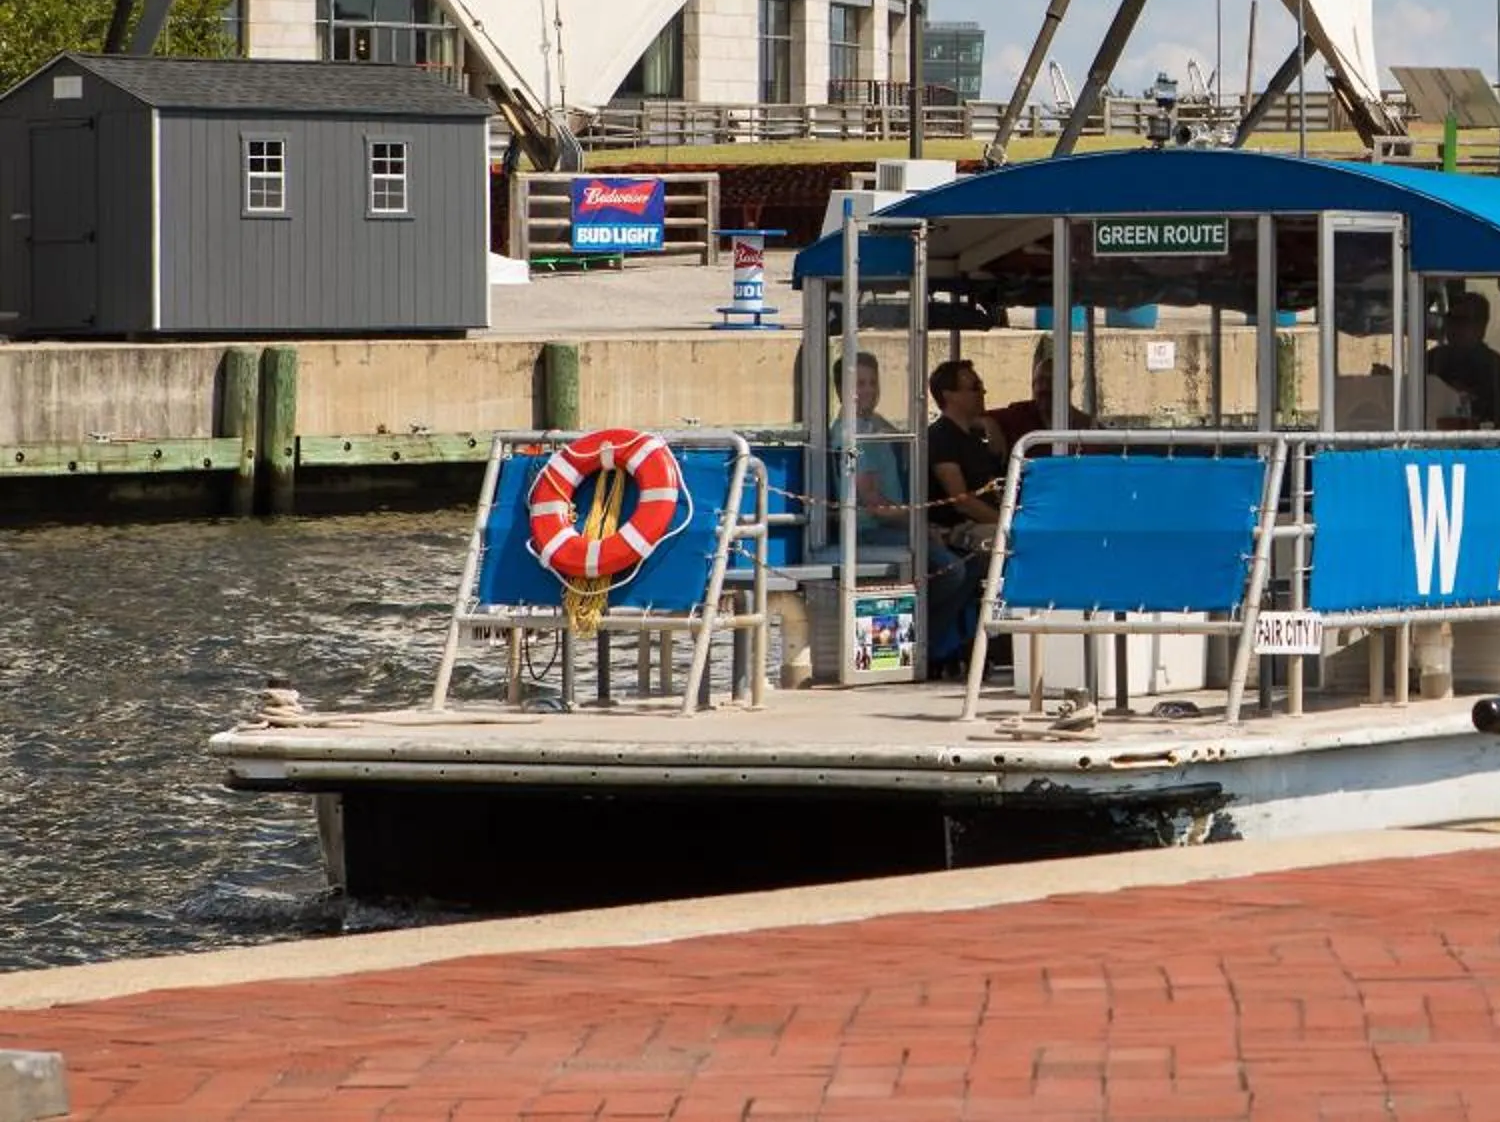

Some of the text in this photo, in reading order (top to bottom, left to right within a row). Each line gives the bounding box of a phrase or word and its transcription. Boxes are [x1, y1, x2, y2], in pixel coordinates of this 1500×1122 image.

[576, 227, 659, 244] BUD LIGHT
[1098, 225, 1225, 245] GREEN ROUTE
[1255, 619, 1282, 647] FAIR
[1286, 619, 1311, 647] CITY
